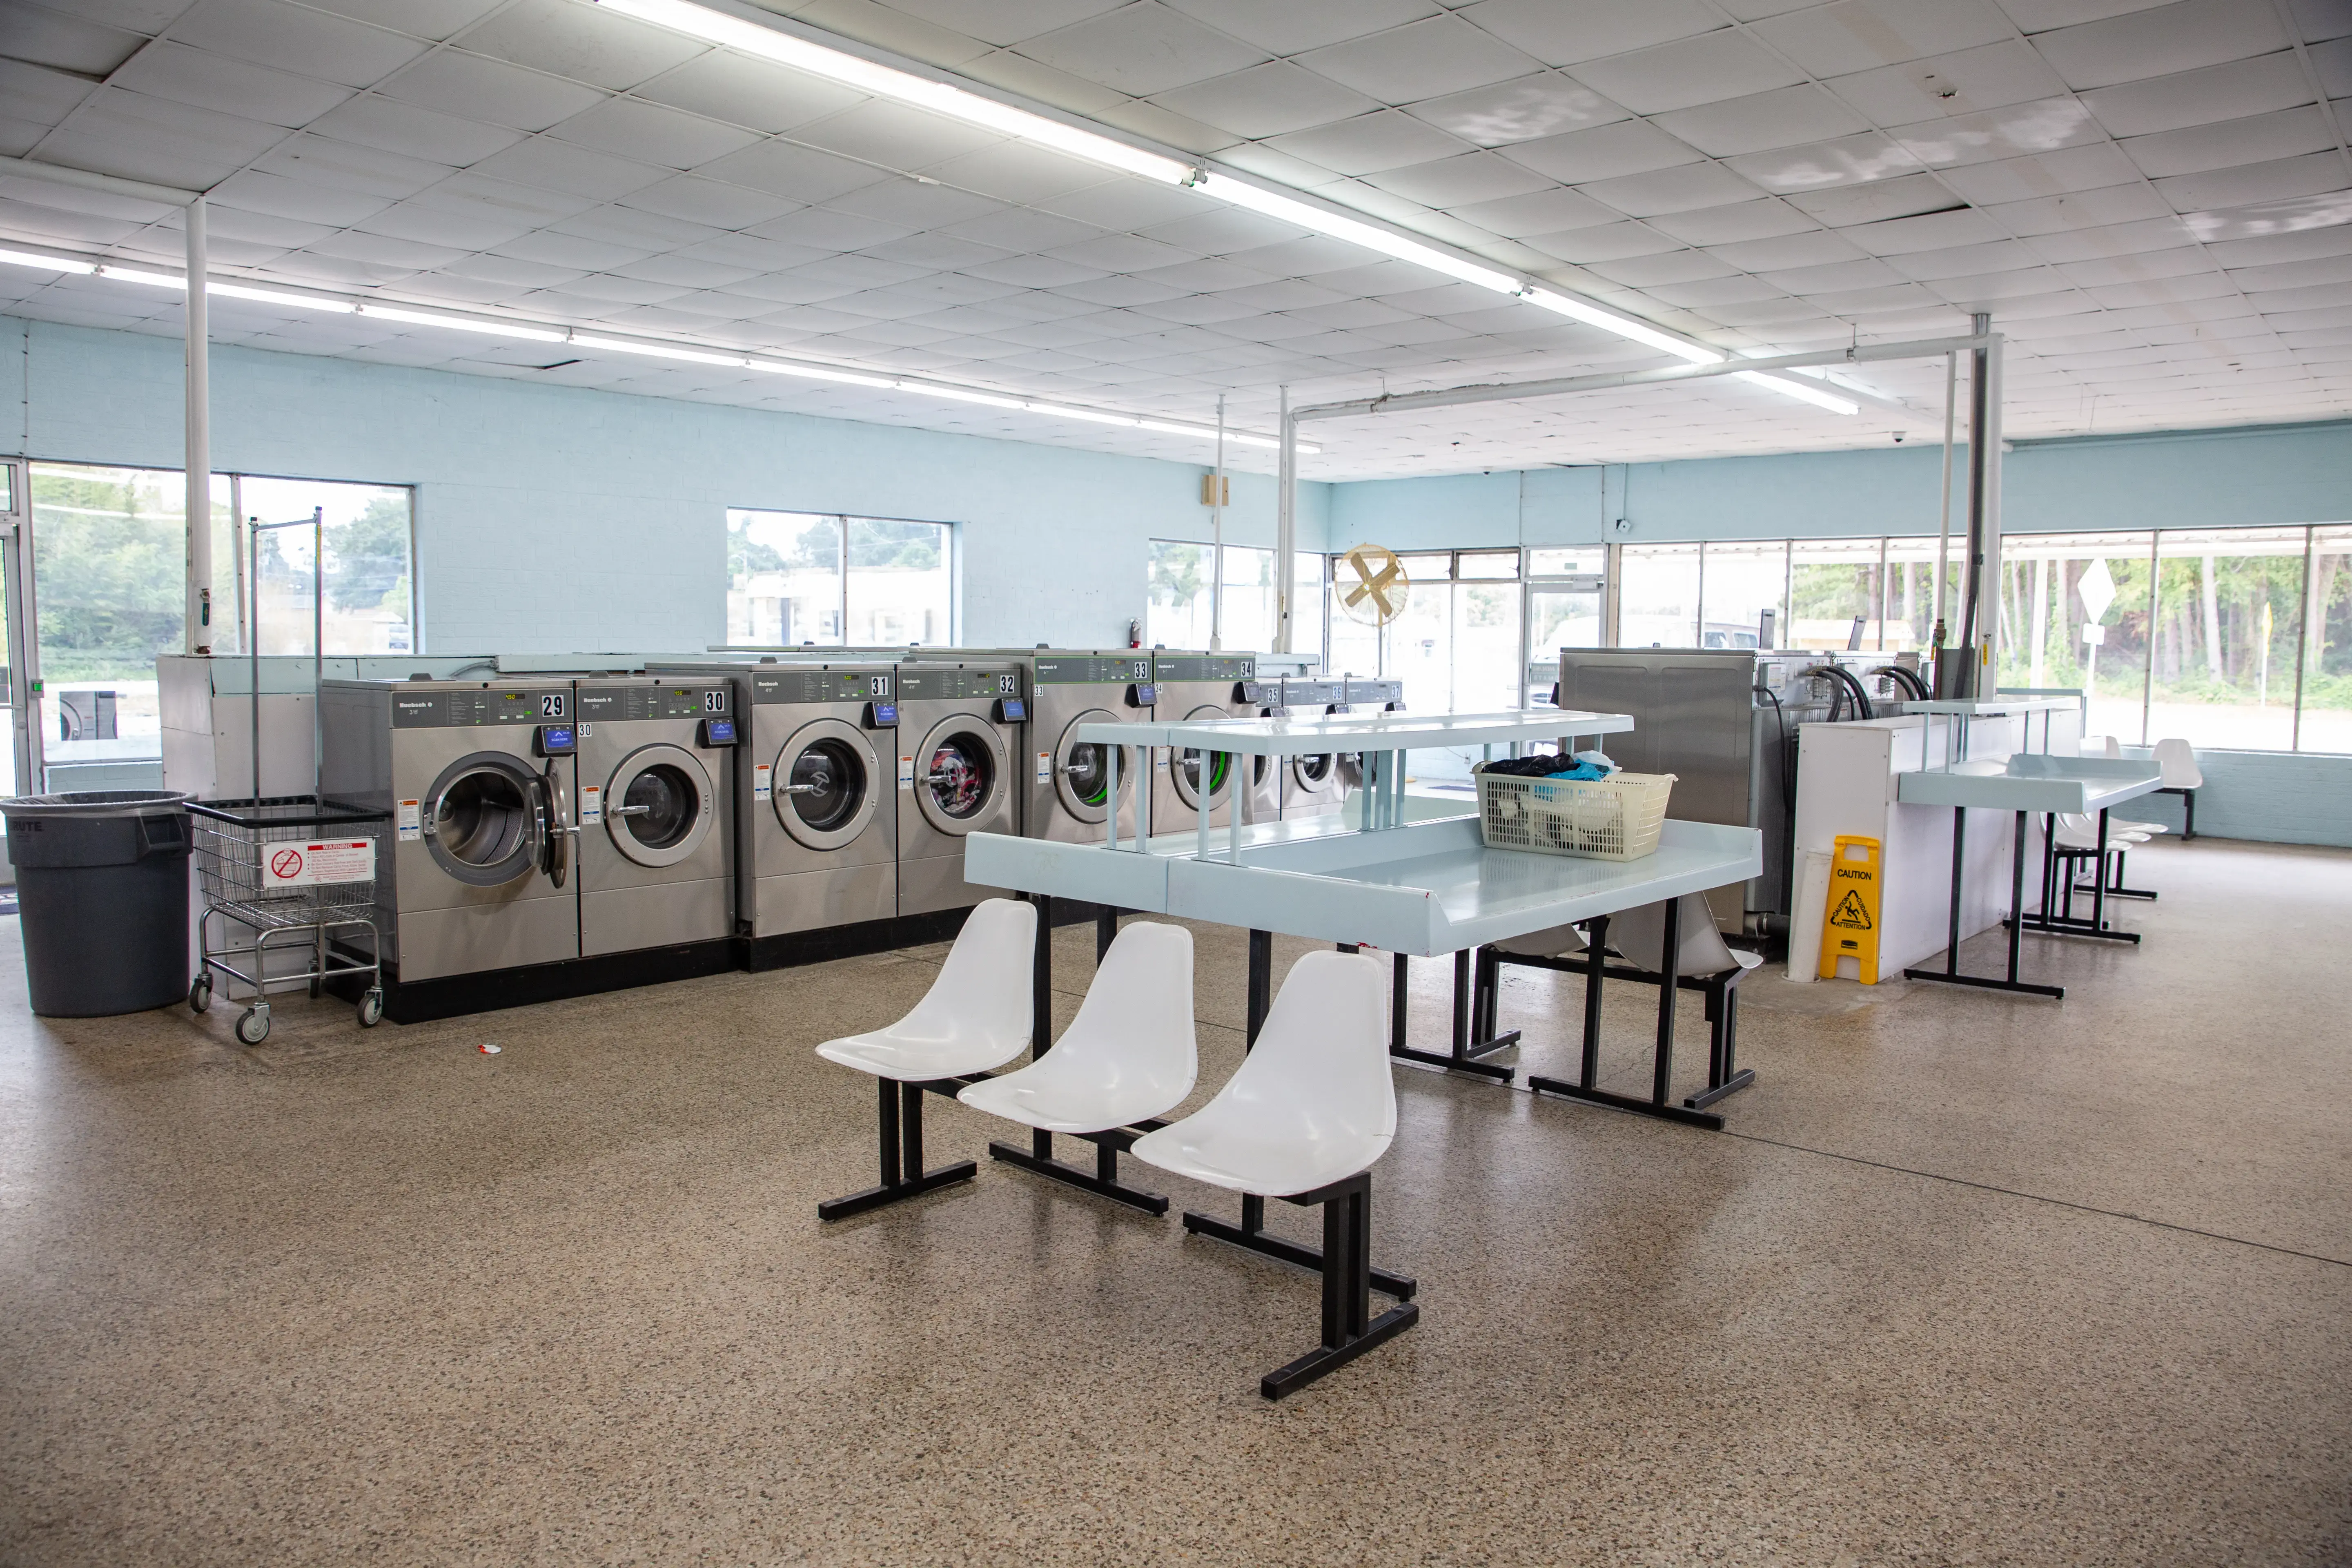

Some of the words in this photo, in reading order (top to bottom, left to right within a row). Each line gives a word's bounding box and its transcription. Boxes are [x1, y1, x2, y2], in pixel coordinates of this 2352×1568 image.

[1136, 663, 1146, 678] 33
[1242, 662, 1251, 676] 34
[873, 677, 885, 694] 31
[1001, 676, 1013, 692] 32
[1035, 686, 1042, 695] 33
[1156, 684, 1162, 693] 34
[1269, 689, 1277, 702] 35
[1333, 687, 1341, 699] 36
[1392, 686, 1399, 697] 37
[543, 696, 562, 716] 29
[707, 693, 723, 710] 30
[579, 724, 590, 735] 30
[1838, 869, 1871, 880] CAUTION
[1833, 895, 1849, 917] CAUTION
[1856, 898, 1870, 921] CUIDADO
[1836, 922, 1865, 930] ATTENTION
